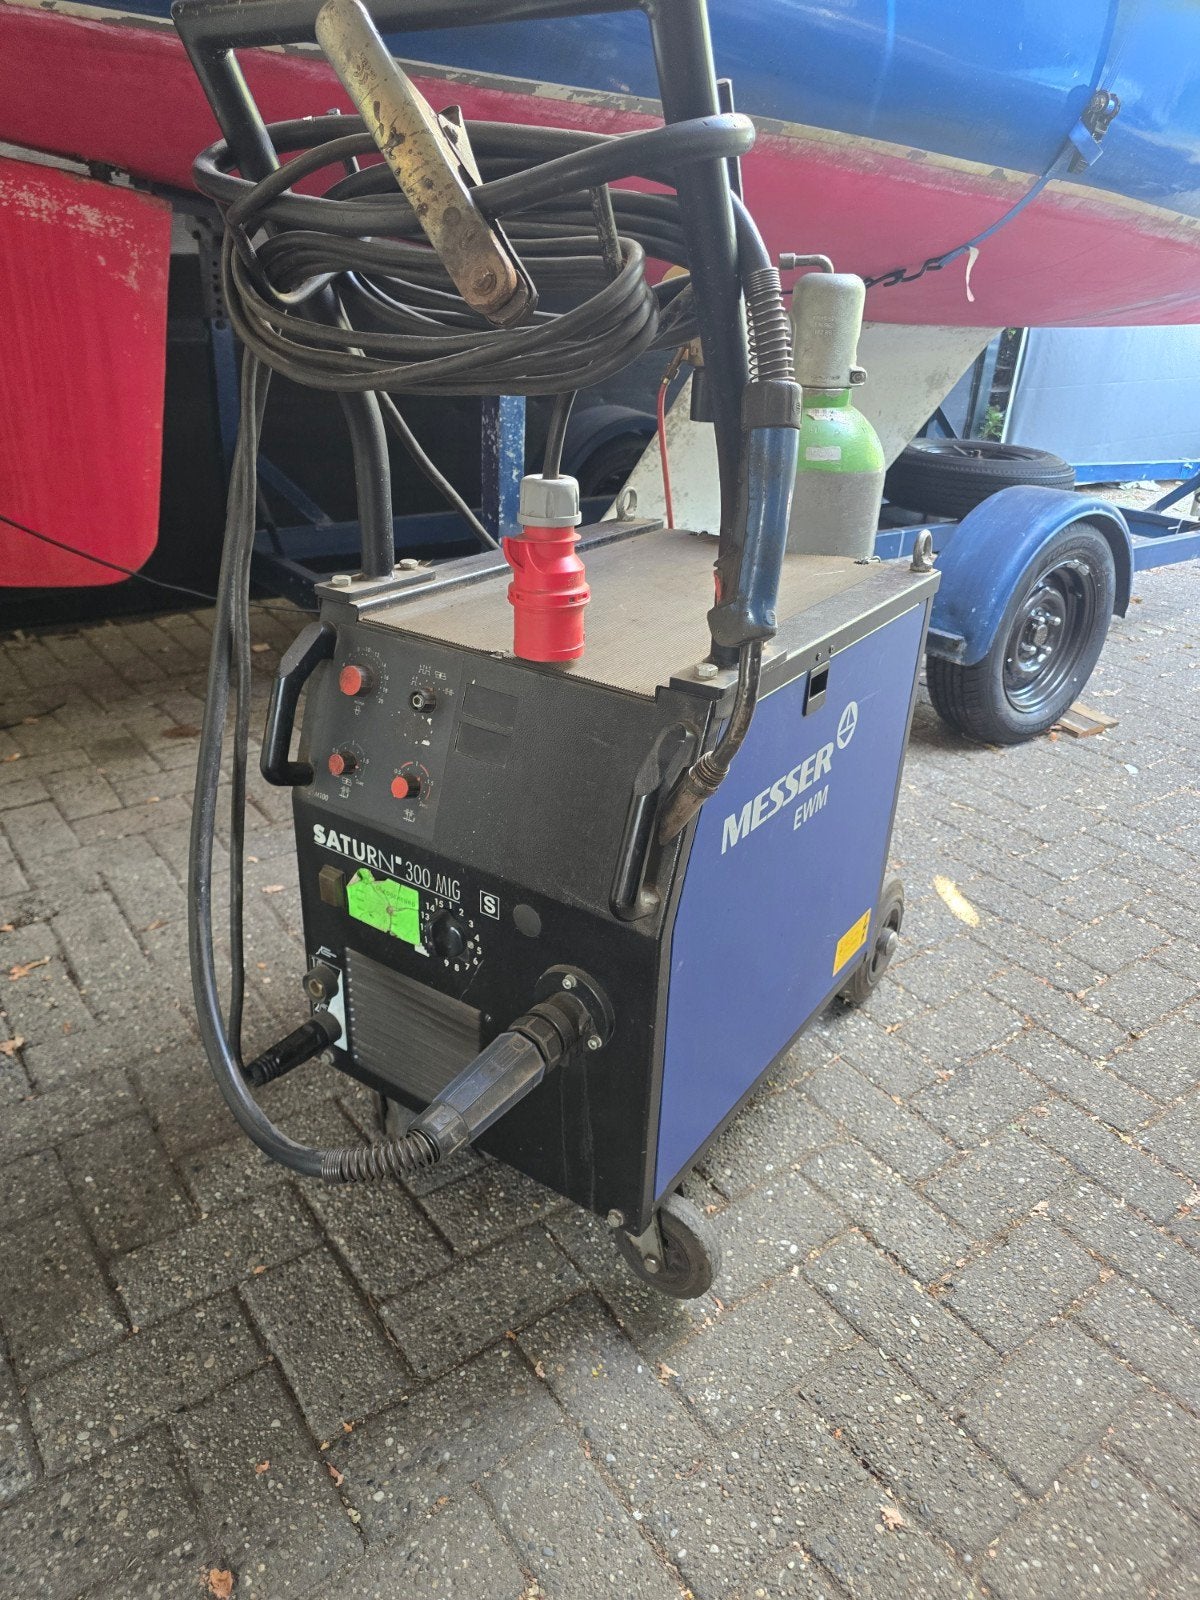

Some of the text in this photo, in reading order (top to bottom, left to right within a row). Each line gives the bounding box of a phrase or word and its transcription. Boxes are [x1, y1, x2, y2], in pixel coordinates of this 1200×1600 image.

[721, 742, 834, 855] MESSER
[793, 784, 829, 831] EWM
[313, 823, 395, 874] SATURN
[405, 861, 430, 888] 300
[436, 873, 461, 900] MIG
[425, 902, 435, 913] 14
[434, 898, 444, 908] 15
[449, 901, 453, 910] 1
[483, 895, 496, 915] S
[421, 911, 430, 921] 13
[459, 908, 465, 917] 2
[468, 920, 474, 928] 3
[474, 934, 480, 942] 4
[476, 946, 482, 955] 5
[444, 959, 450, 967] 9
[473, 957, 479, 966] 6
[454, 963, 460, 972] 8
[465, 963, 470, 971] 7
